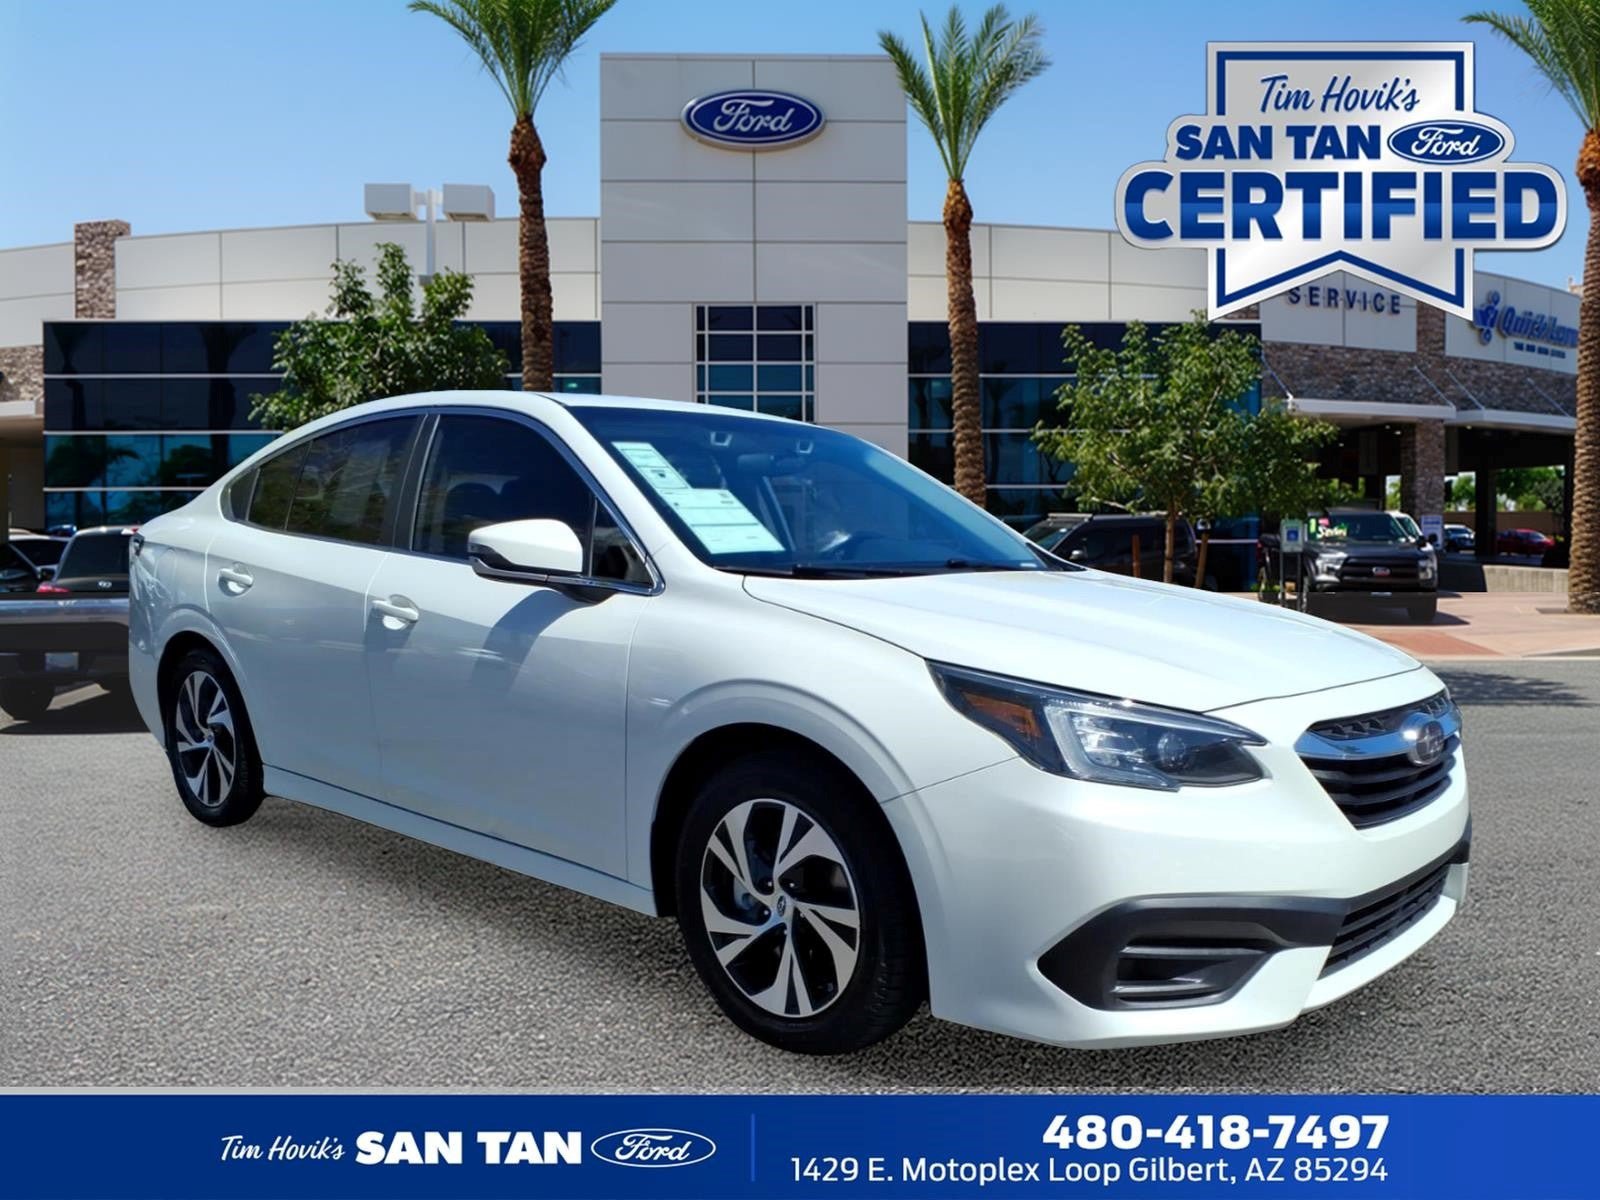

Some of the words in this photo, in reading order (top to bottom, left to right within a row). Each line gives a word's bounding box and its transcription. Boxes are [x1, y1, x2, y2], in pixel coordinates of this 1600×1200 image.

[712, 99, 796, 132] Ford
[1288, 286, 1401, 315] SERVICE
[1549, 315, 1578, 348] Lan
